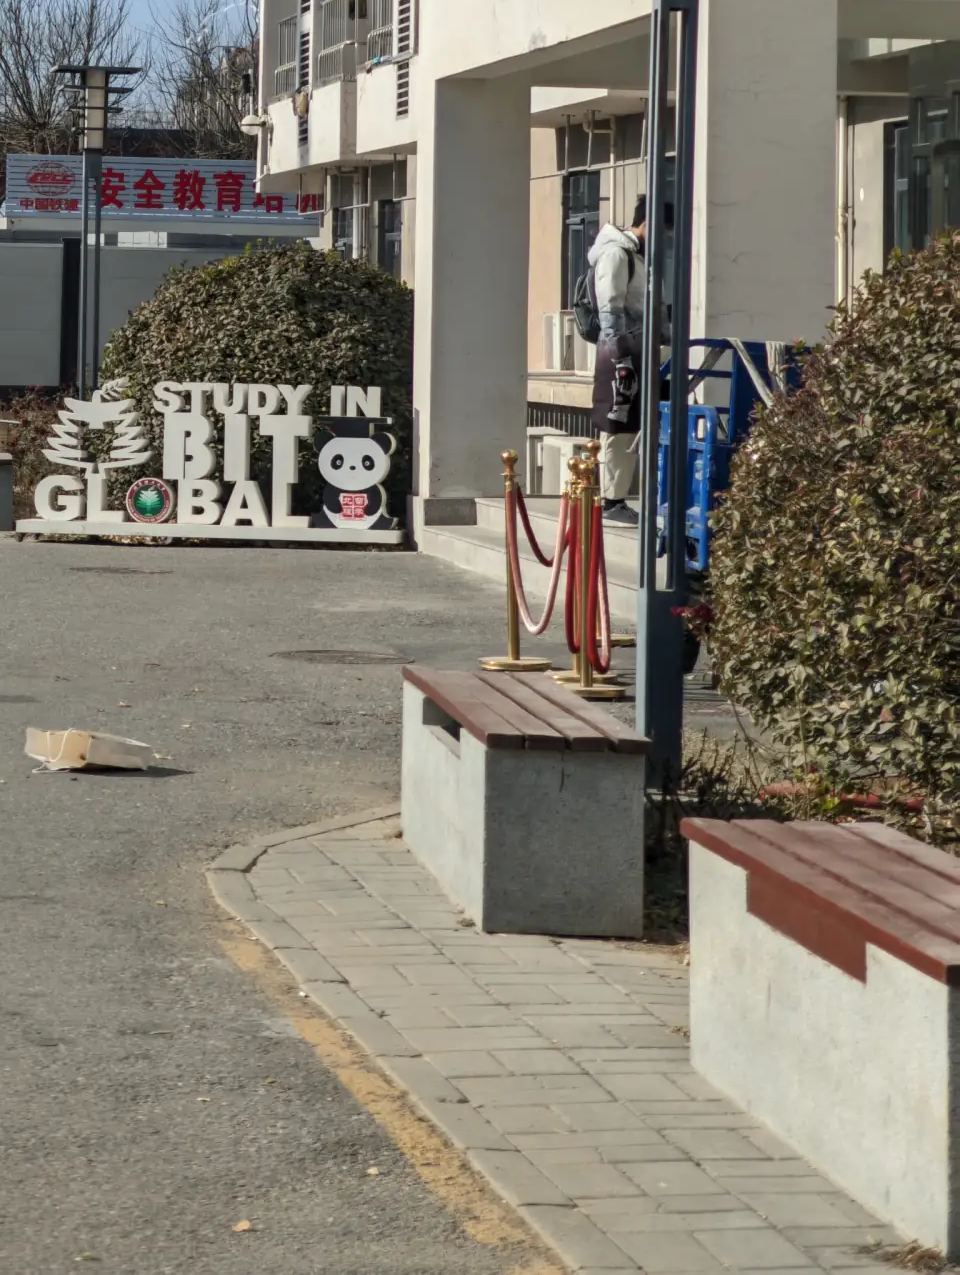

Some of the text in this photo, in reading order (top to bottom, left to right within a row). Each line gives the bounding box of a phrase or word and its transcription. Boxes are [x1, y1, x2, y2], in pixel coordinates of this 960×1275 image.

[153, 381, 382, 417] STUDY IN
[163, 412, 313, 485] BIT
